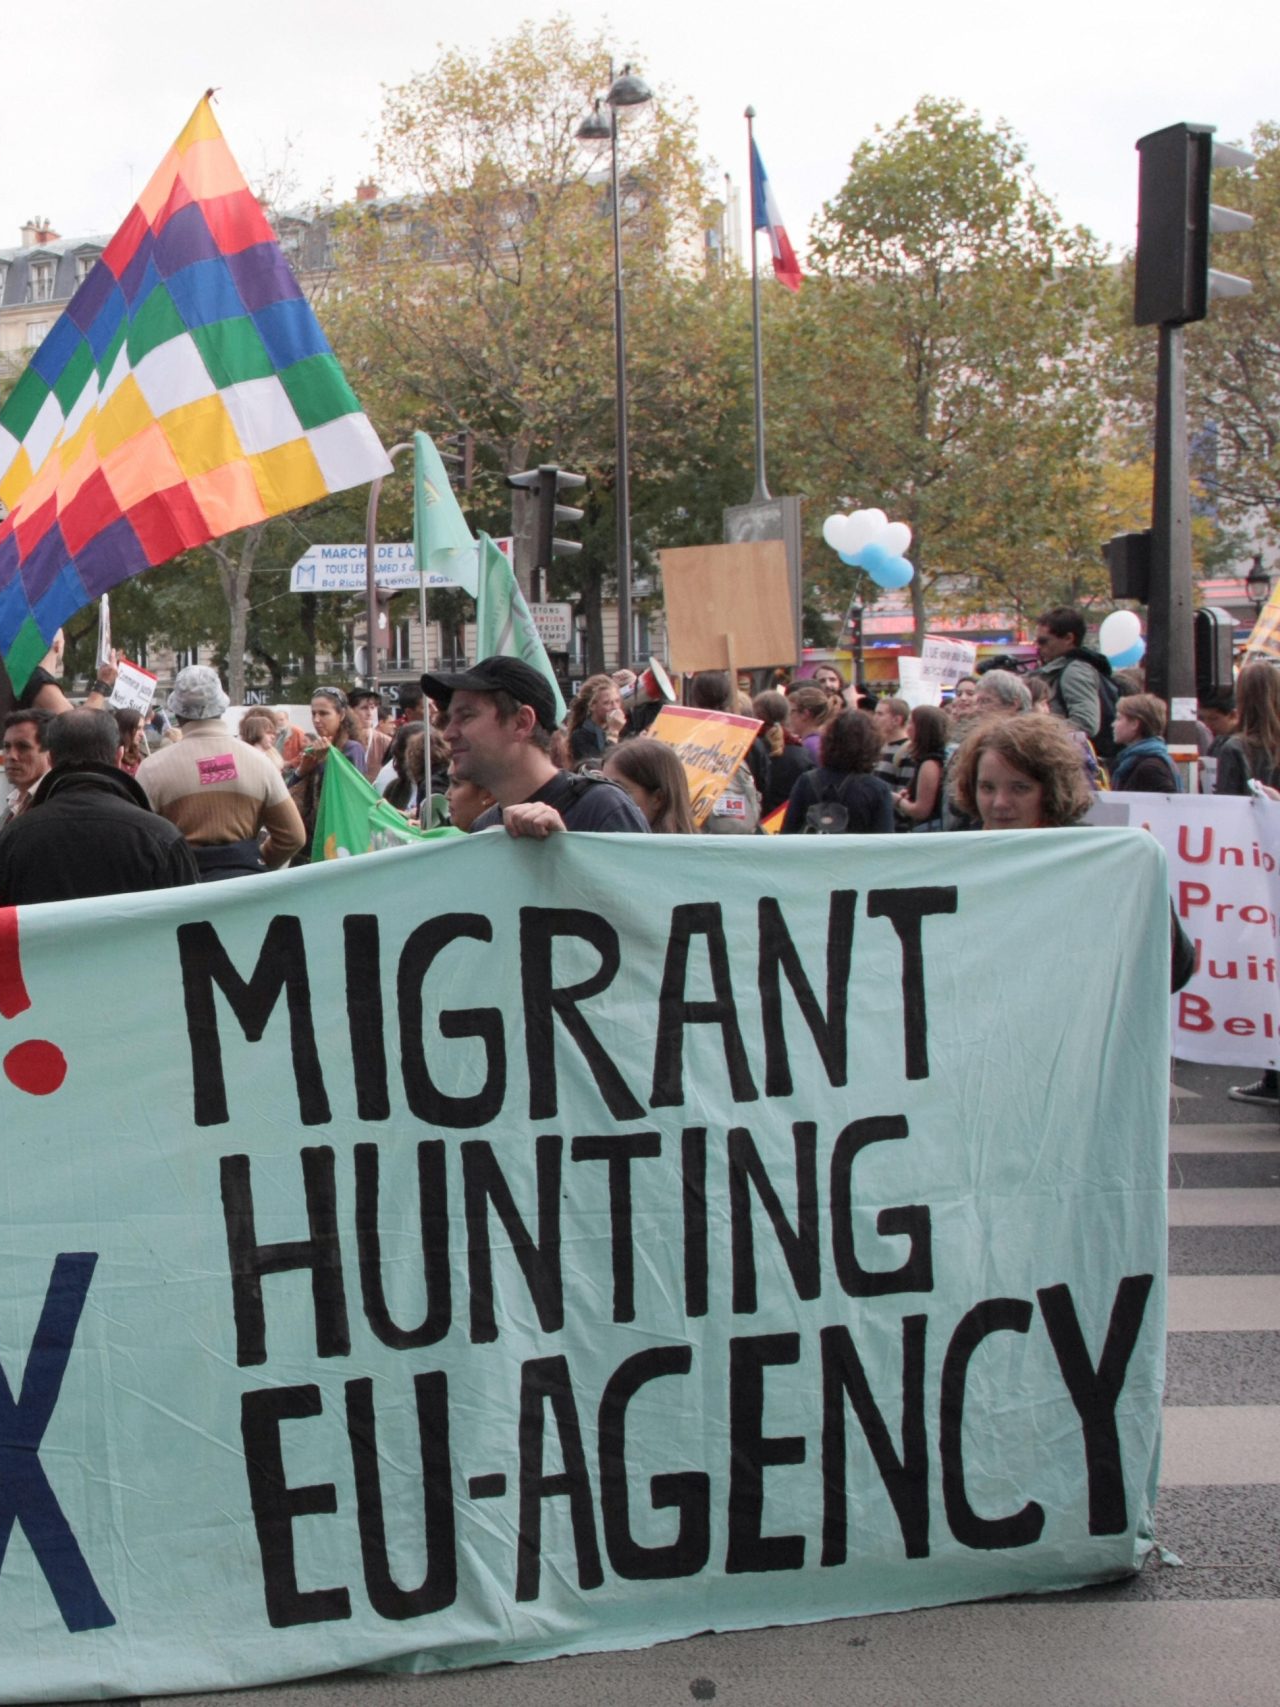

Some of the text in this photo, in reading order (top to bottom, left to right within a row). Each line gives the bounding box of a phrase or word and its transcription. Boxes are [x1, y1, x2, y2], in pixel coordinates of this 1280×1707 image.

[321, 547, 368, 559] MARCH
[378, 547, 394, 558] DE
[325, 564, 348, 574] TOUS
[1178, 825, 1277, 873] Unio
[176, 885, 959, 1130] MIGRANT
[1178, 992, 1280, 1040] Bel
[220, 1114, 935, 1368] HUNTING
[241, 1272, 1155, 1629] EU-AGENCY
